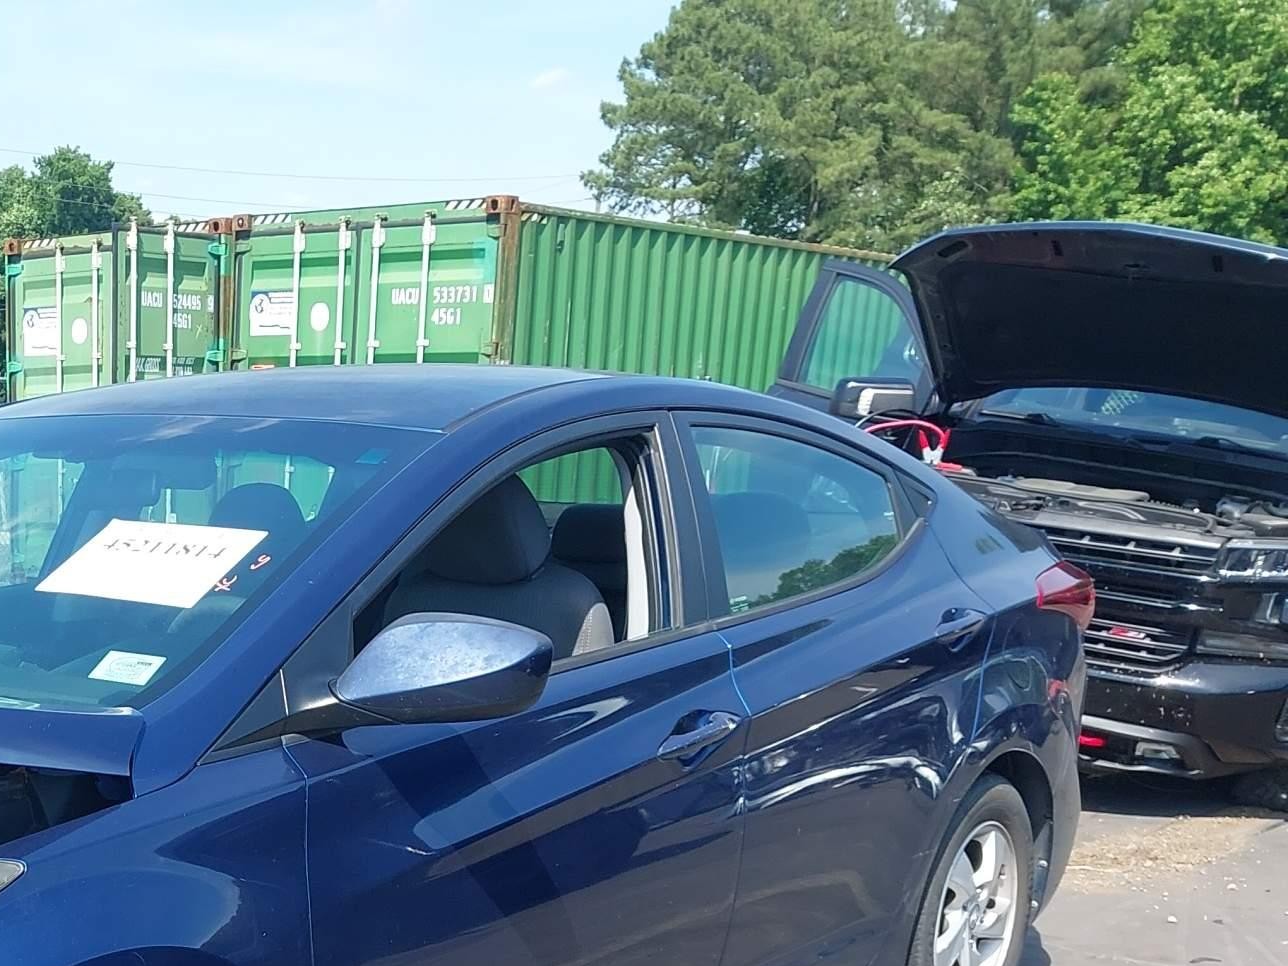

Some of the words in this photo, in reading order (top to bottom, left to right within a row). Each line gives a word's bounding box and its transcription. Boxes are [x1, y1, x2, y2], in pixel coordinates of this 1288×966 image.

[141, 291, 163, 308] UACU
[172, 293, 201, 311] 524495
[392, 287, 419, 305] UACU
[433, 285, 478, 304] 533731
[431, 307, 462, 325] 45G1
[103, 538, 228, 560] 45211814
